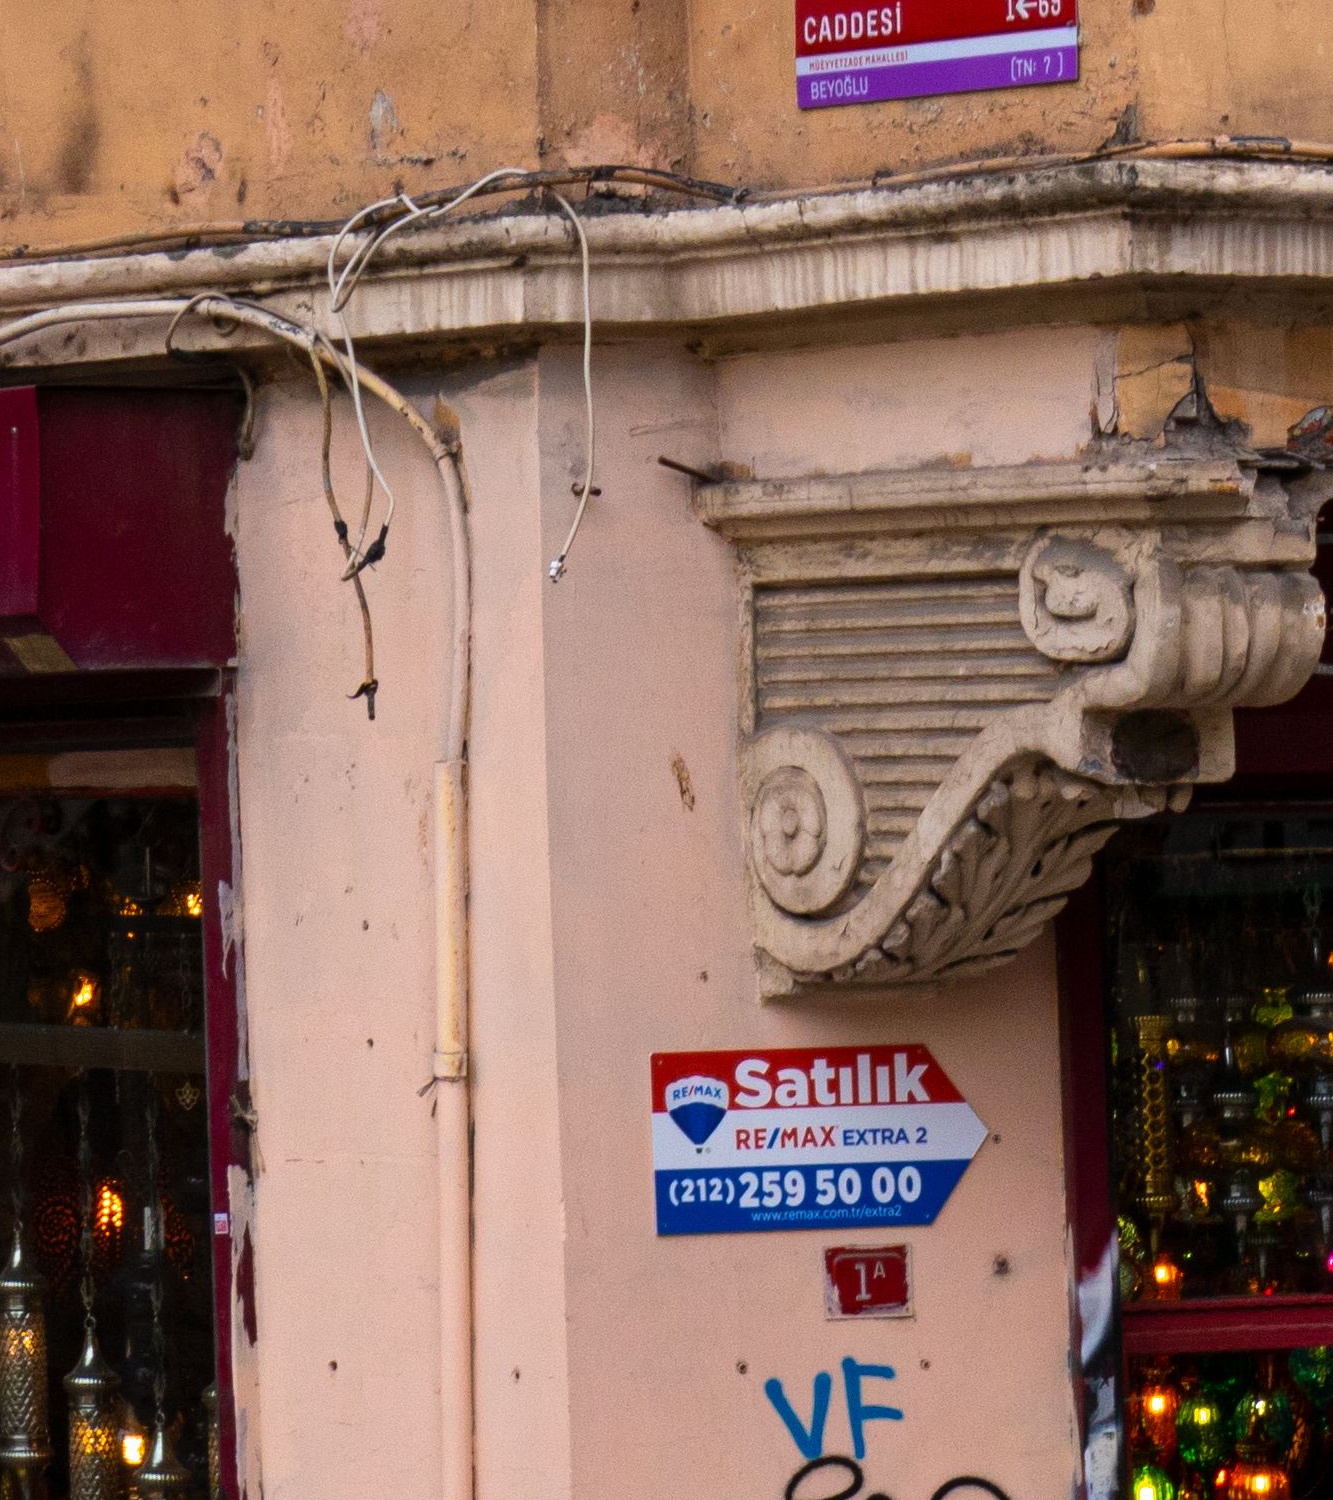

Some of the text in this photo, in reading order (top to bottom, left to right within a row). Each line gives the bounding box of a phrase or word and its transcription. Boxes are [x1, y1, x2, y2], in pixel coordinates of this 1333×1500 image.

[804, 1, 902, 45] CADDESİ
[811, 73, 869, 99] BEYOĞLU
[673, 1085, 722, 1100] RE/MAX
[734, 1053, 931, 1108] Satılık
[735, 1125, 928, 1150] RE/MAX EXTRA 2
[669, 1166, 922, 1208] (212) 259 50 00
[751, 1205, 902, 1223] www.remax.com.tr/extra2
